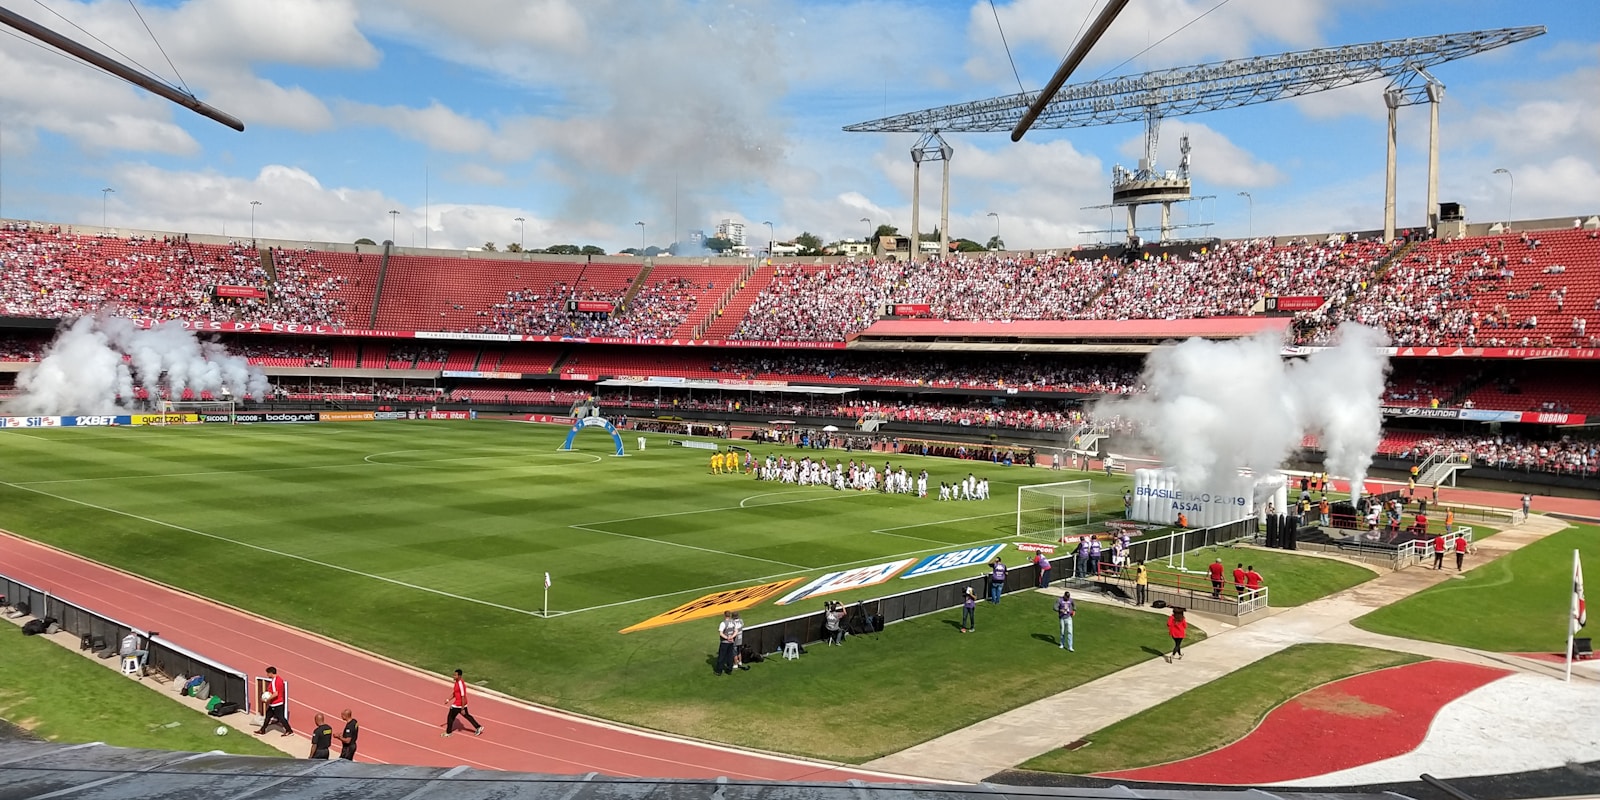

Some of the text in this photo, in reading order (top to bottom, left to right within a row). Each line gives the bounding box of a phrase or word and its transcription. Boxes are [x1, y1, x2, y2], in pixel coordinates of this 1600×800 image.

[208, 286, 214, 294] 7
[571, 301, 576, 310] 8
[1266, 298, 1276, 309] 10
[887, 305, 893, 314] 9
[1576, 349, 1594, 357] TEM
[265, 413, 315, 422] bodog.net
[431, 411, 447, 419] inter
[450, 411, 466, 419] inter
[1421, 408, 1458, 418] HYUNDAI
[26, 416, 42, 426] Sil
[75, 415, 117, 426] 1XBET
[1538, 413, 1569, 423] URBANO
